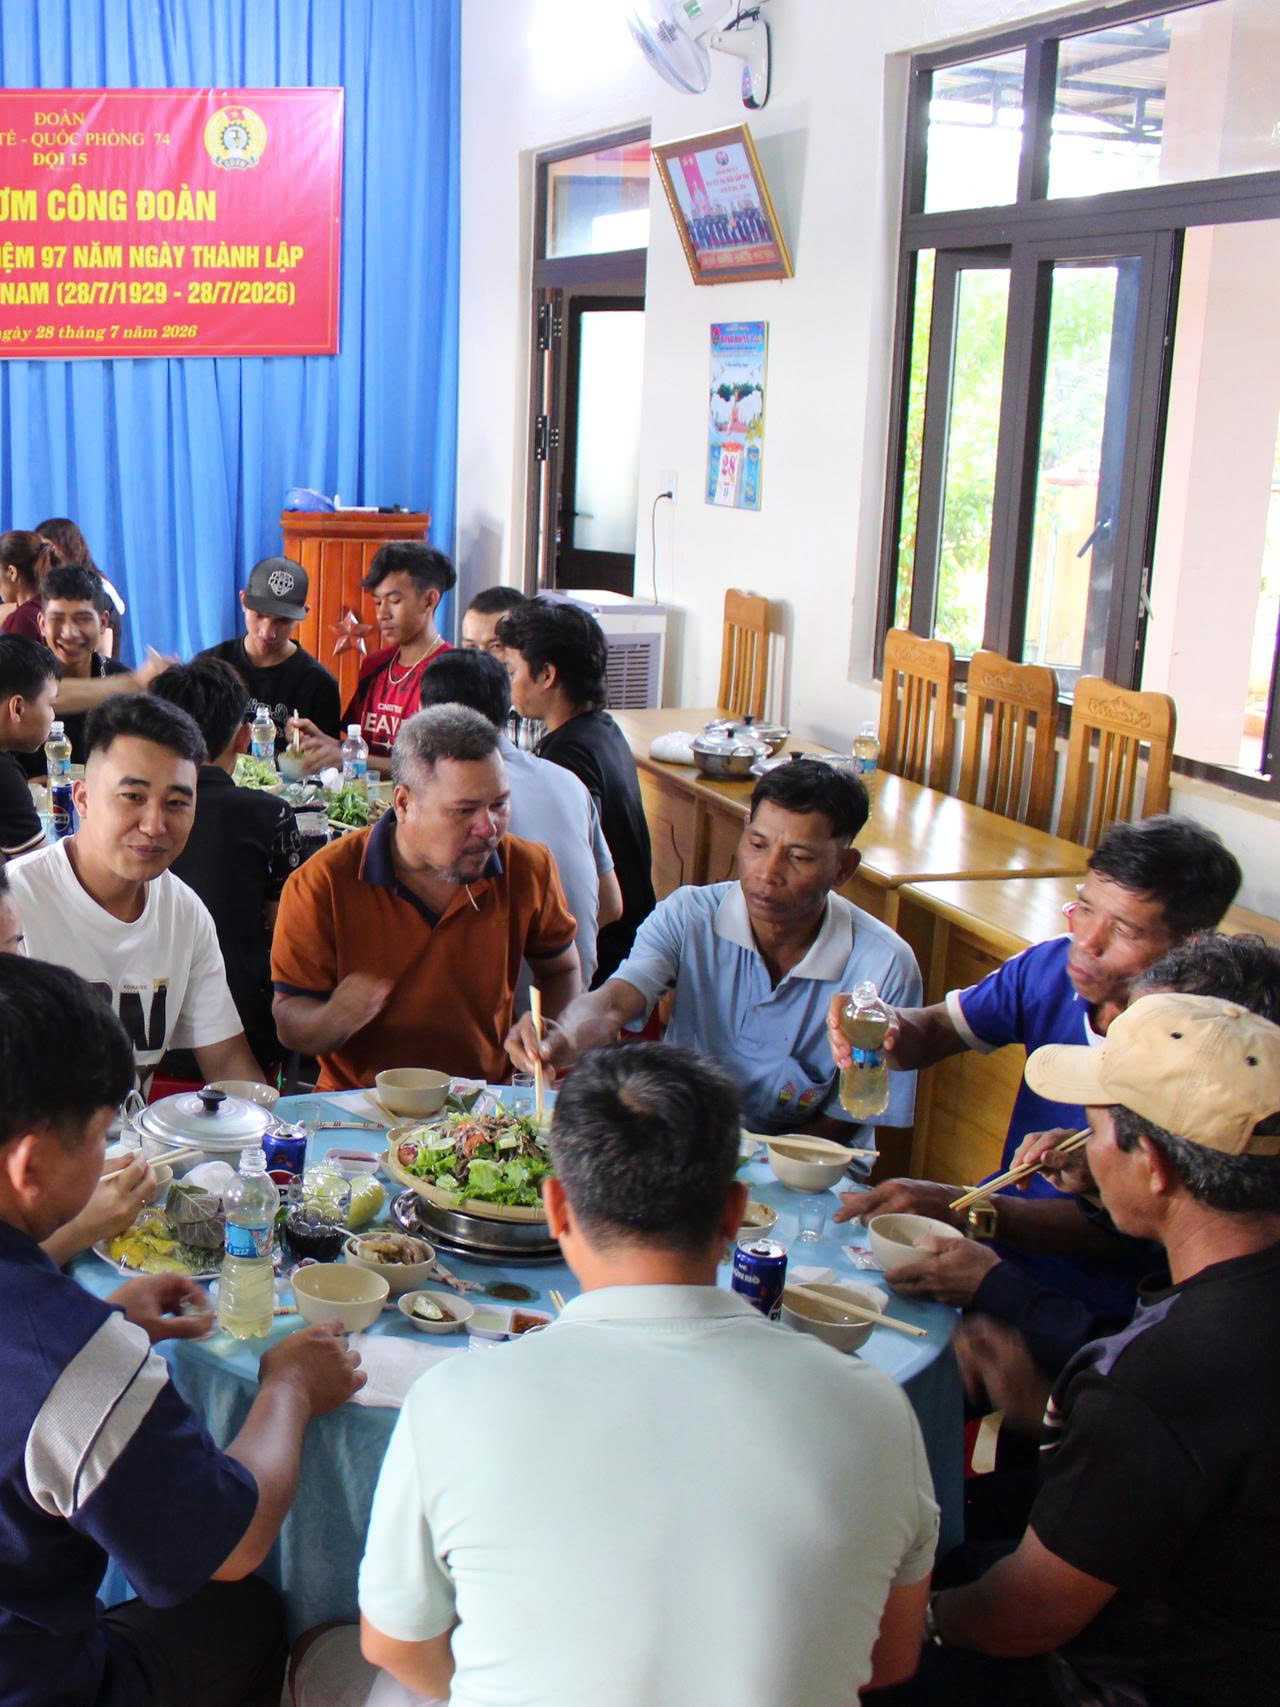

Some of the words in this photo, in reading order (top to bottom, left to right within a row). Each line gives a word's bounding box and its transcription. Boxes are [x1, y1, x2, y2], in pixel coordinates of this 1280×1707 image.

[34, 108, 85, 126] ĐOÀN
[31, 128, 81, 148] QUỐC
[85, 128, 145, 146] PHÒNG
[154, 132, 171, 145] 74
[32, 150, 65, 169] ĐỘI
[71, 152, 88, 166] 15
[47, 183, 128, 222] CÔNG
[136, 183, 217, 222] ĐOÀN
[41, 246, 67, 269] 97
[73, 240, 123, 269] NĂM
[129, 240, 185, 269] NGÀY
[192, 240, 260, 269] THÀNH
[265, 240, 304, 273] LẬP
[0, 282, 50, 305] NAM
[56, 281, 168, 307] (28/7/1929
[187, 280, 297, 306] 28/7/2026)
[35, 325, 55, 340] 28
[59, 324, 106, 341] tháng
[110, 325, 121, 339] 7
[123, 325, 158, 339] năm
[161, 325, 198, 339] 2026
